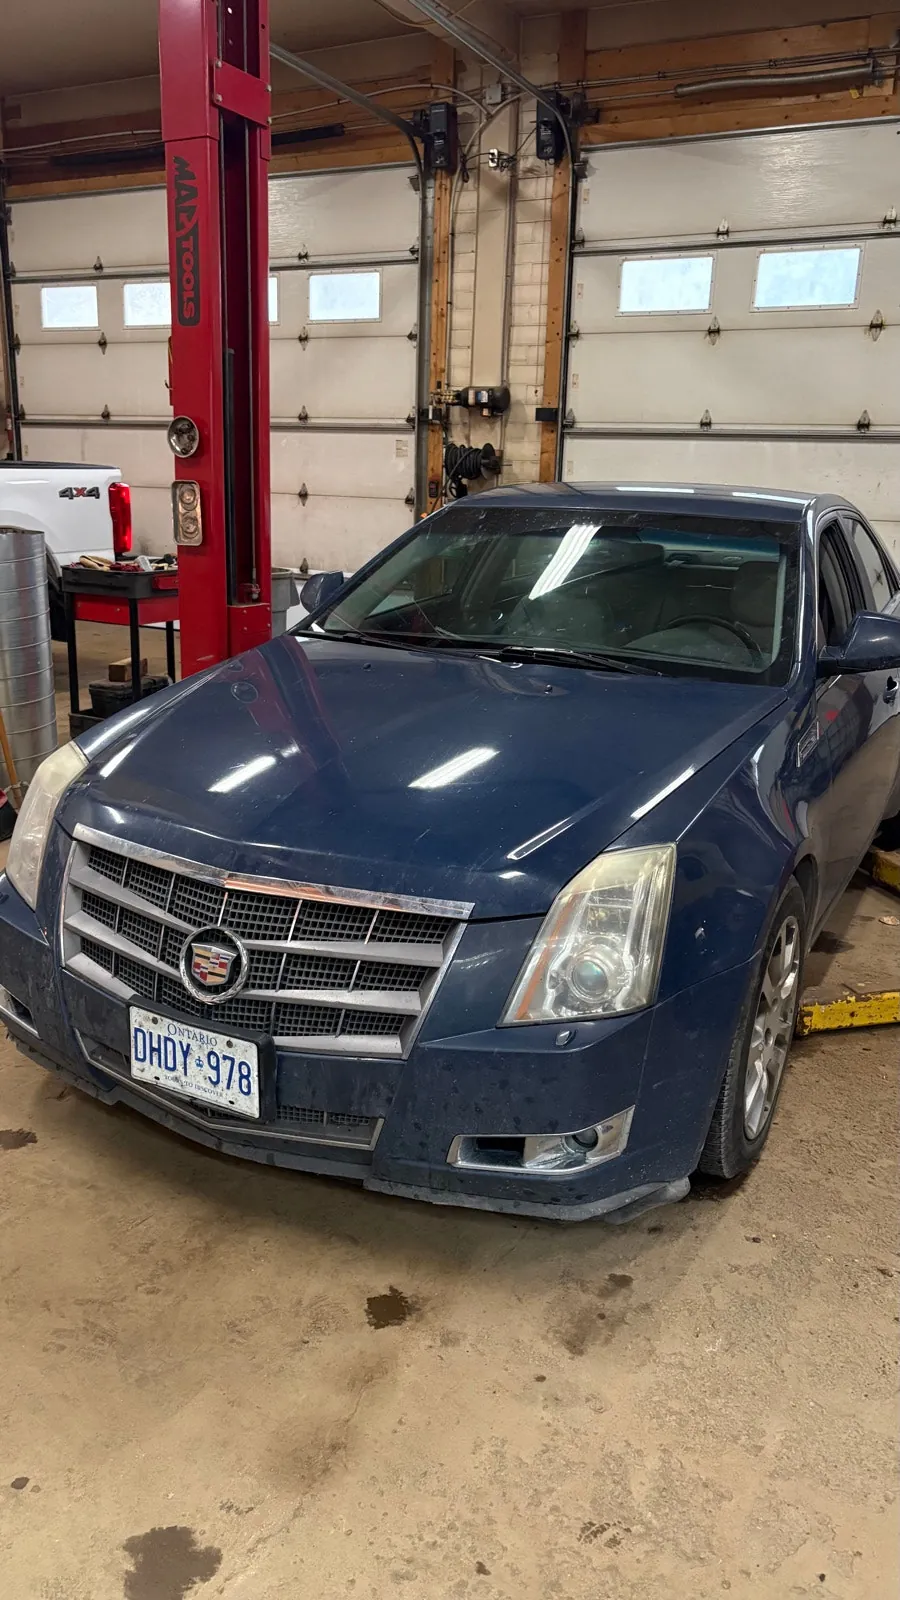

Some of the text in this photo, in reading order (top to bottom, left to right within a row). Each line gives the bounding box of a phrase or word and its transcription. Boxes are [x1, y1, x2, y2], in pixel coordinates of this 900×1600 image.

[181, 236, 195, 319] TOOLS
[133, 1027, 252, 1096] DHDY 978
